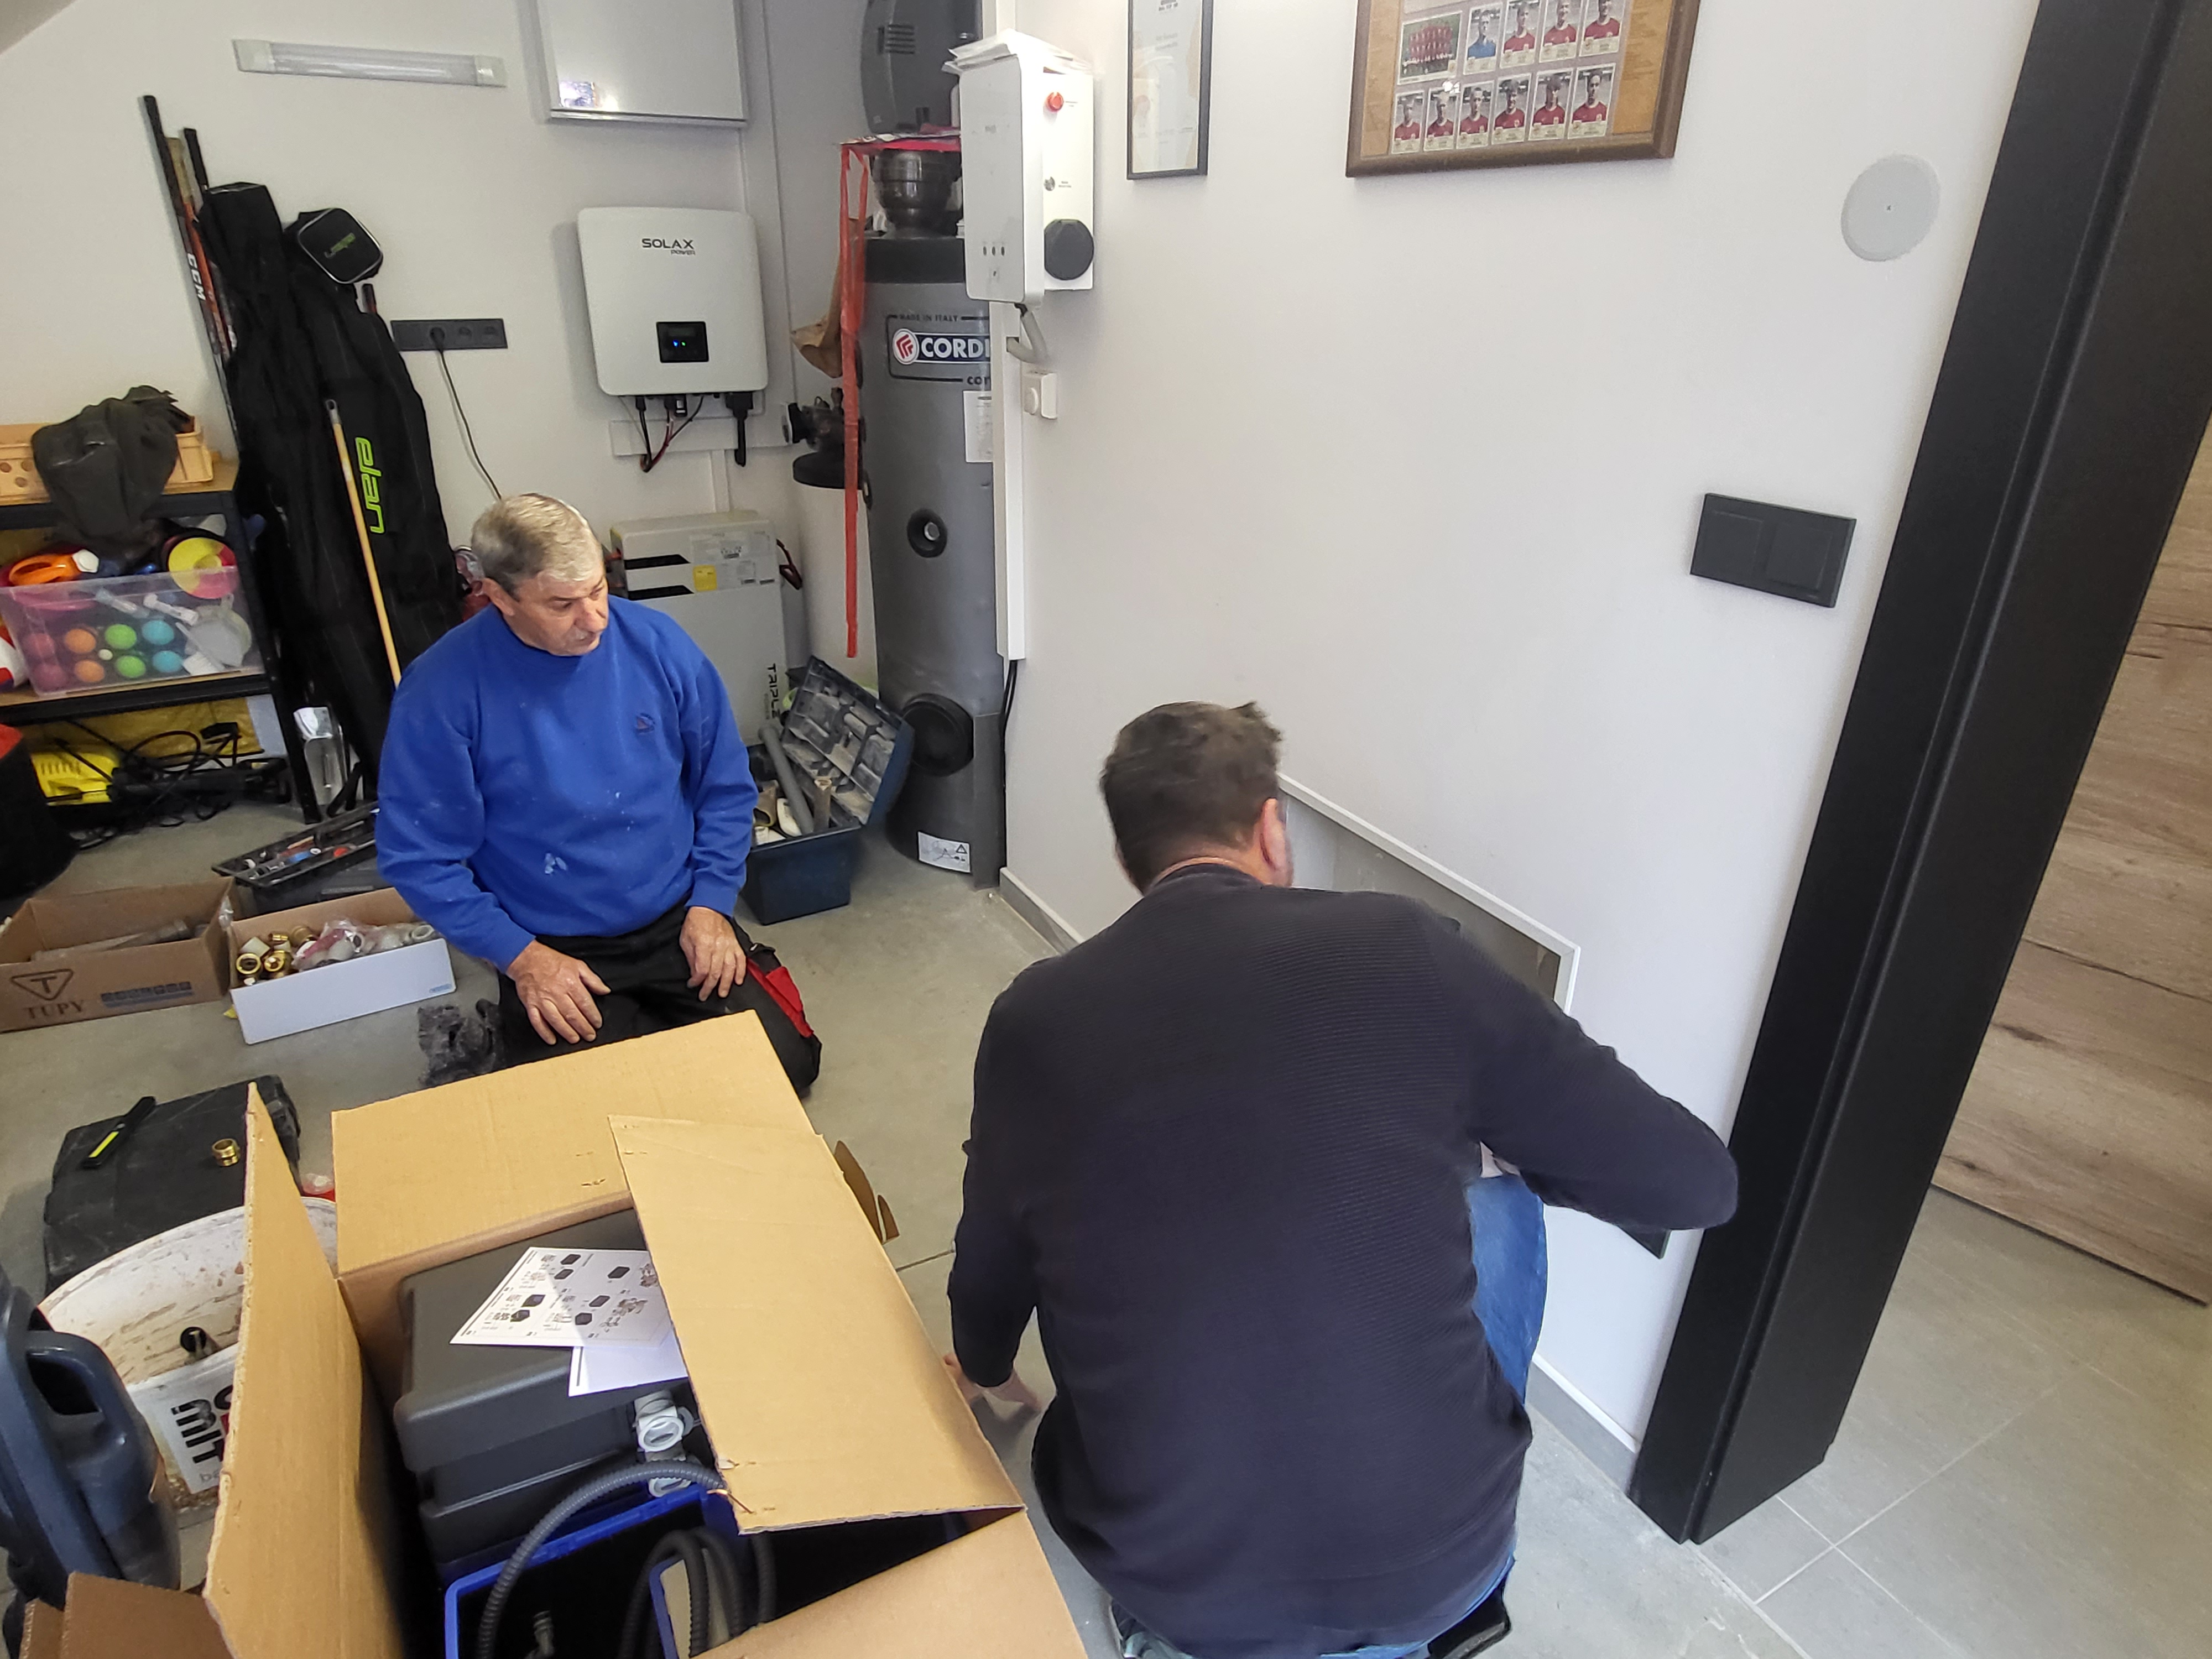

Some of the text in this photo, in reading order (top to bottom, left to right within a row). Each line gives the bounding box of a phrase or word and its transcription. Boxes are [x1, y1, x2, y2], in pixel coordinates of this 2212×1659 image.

[641, 238, 694, 249] SOLAX
[187, 252, 206, 301] CCM
[354, 436, 385, 534] elan
[767, 662, 781, 719] TRIPLE
[24, 1000, 84, 1020] TUPY
